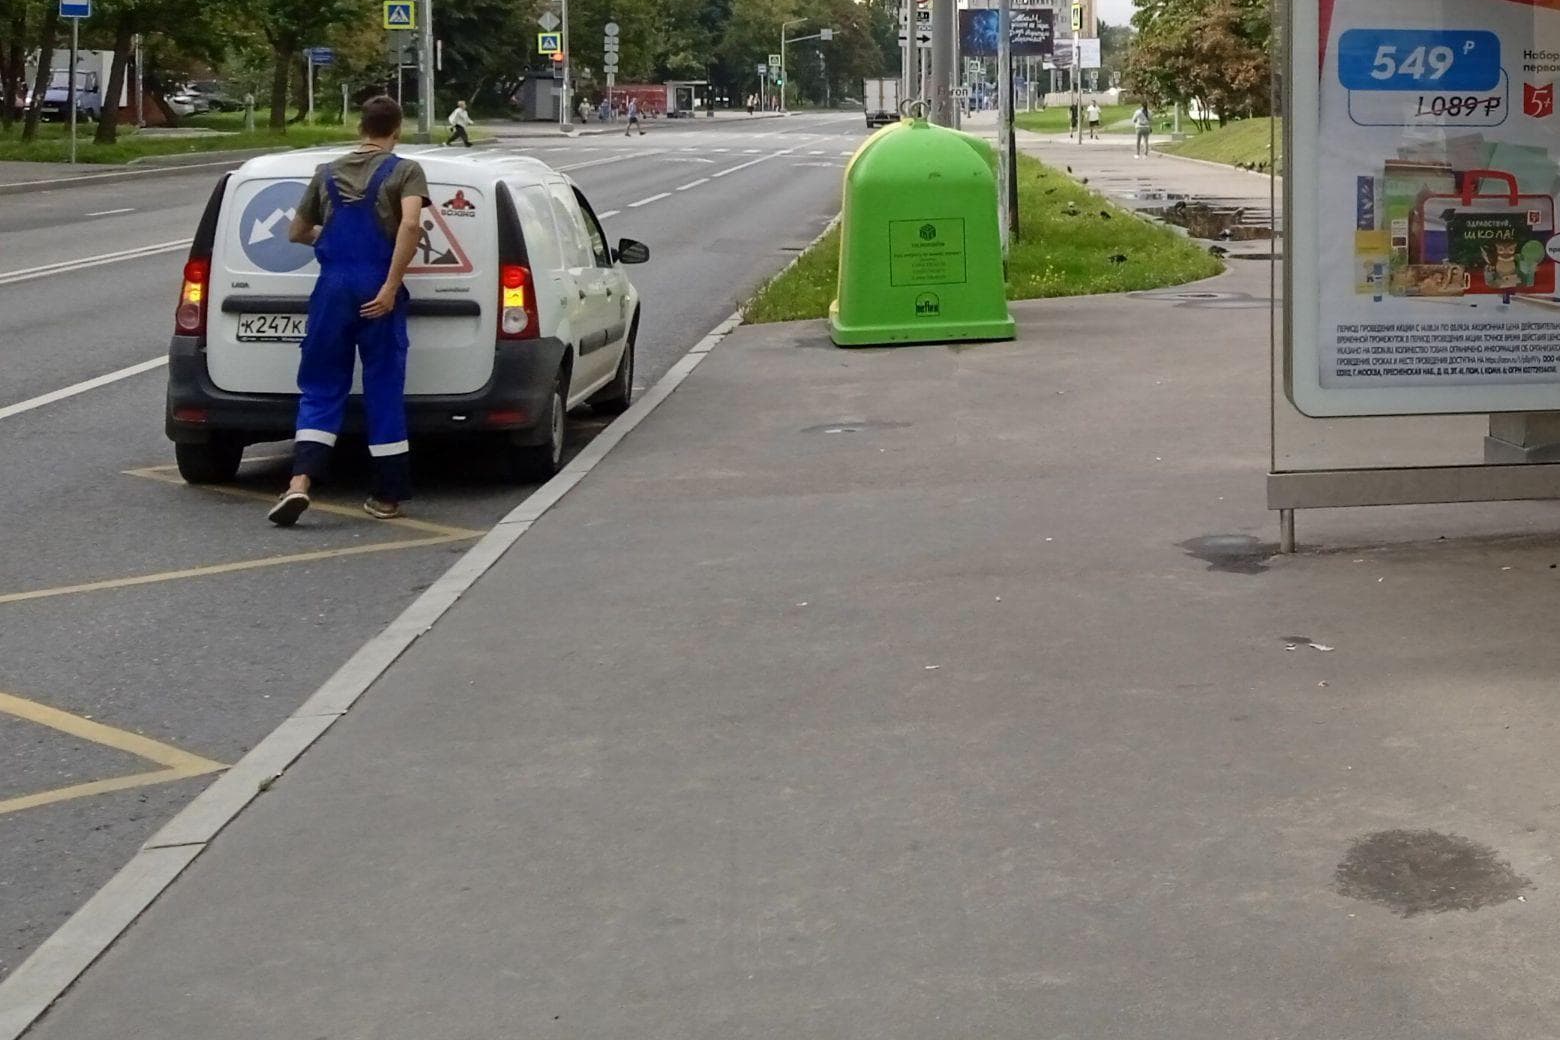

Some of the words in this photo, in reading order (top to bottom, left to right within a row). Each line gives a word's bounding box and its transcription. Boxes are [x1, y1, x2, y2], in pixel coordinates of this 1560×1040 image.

[1523, 49, 1560, 62] Набор
[1370, 45, 1455, 81] 549
[1464, 228, 1515, 240] ШКОЛА!
